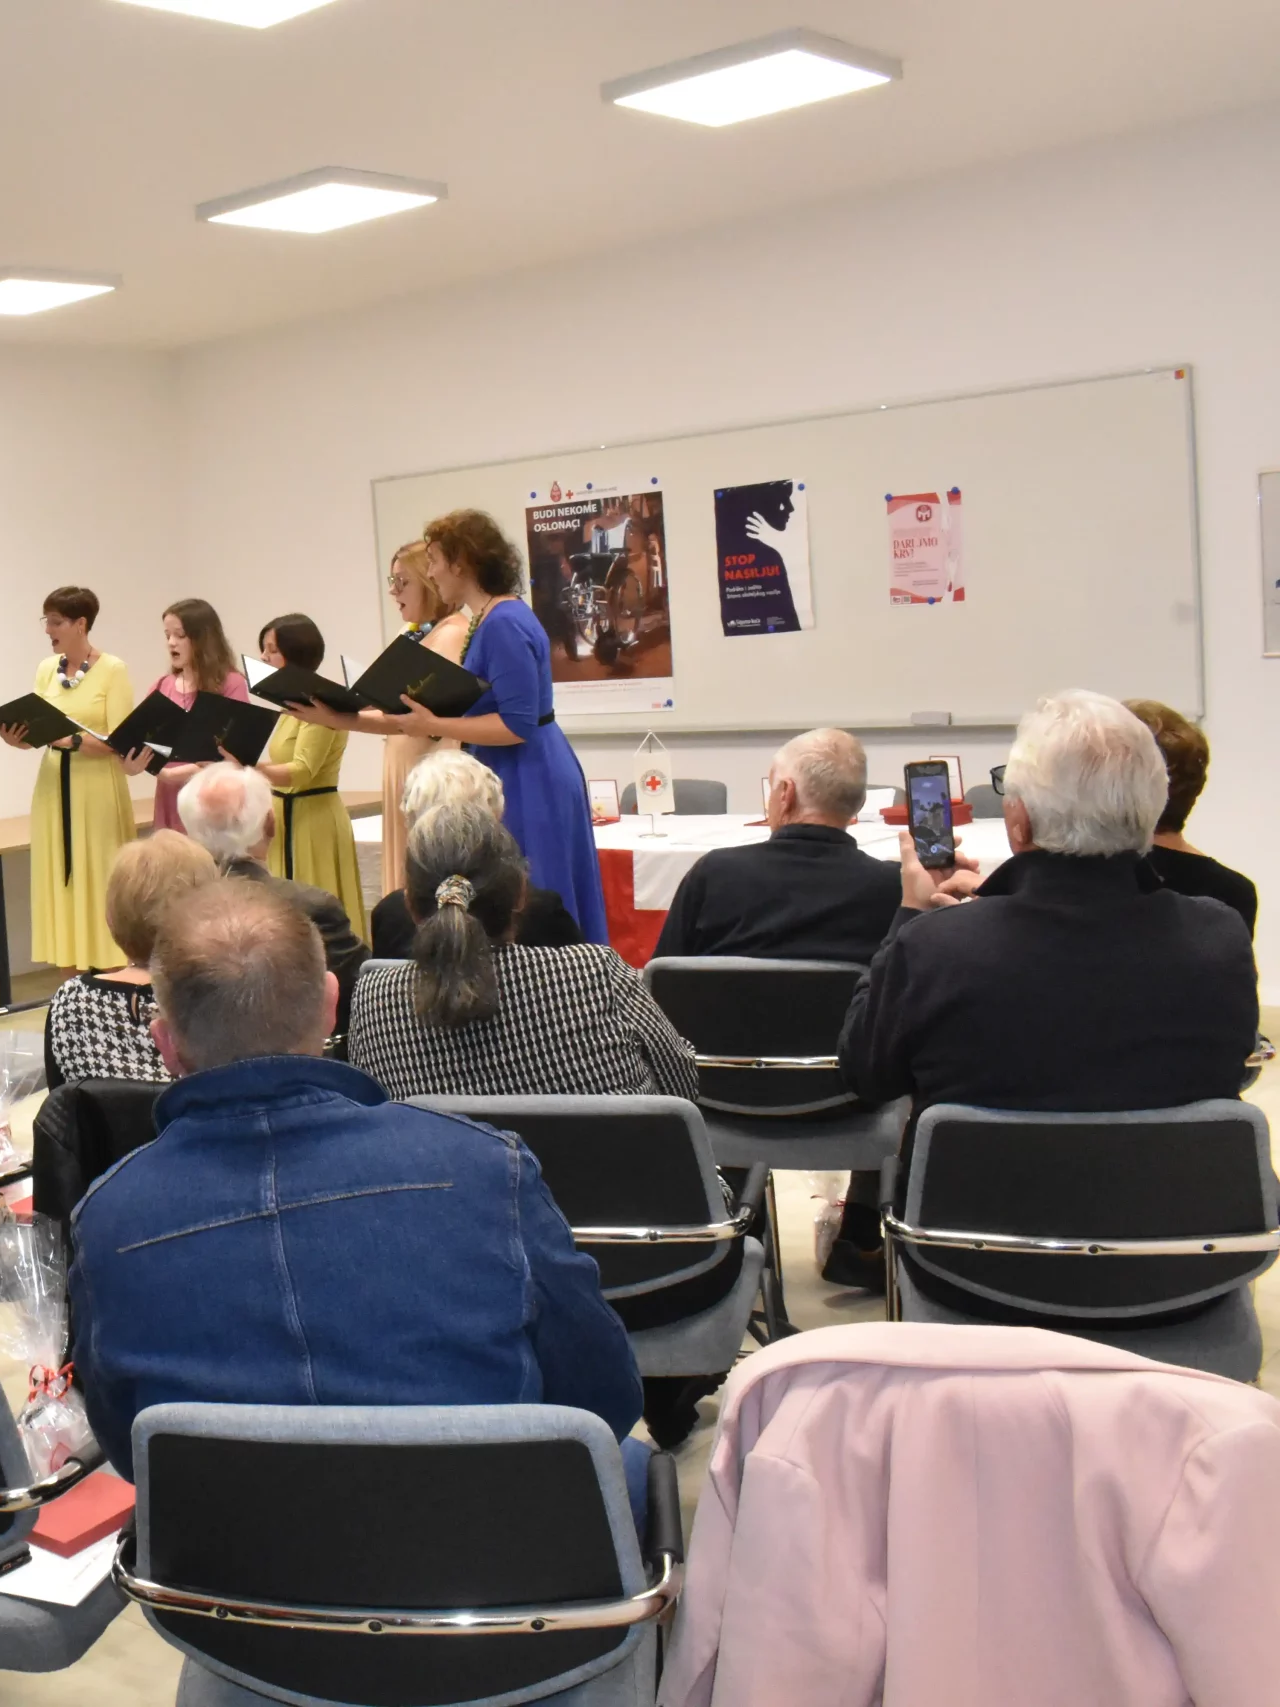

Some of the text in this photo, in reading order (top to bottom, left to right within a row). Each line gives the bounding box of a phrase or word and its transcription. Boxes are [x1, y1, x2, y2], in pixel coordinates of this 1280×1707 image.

[533, 503, 598, 520] BUDI NEKOME
[533, 519, 581, 532] OSLONAC!
[724, 553, 756, 567] STOP
[724, 564, 781, 580] NASILJU!
